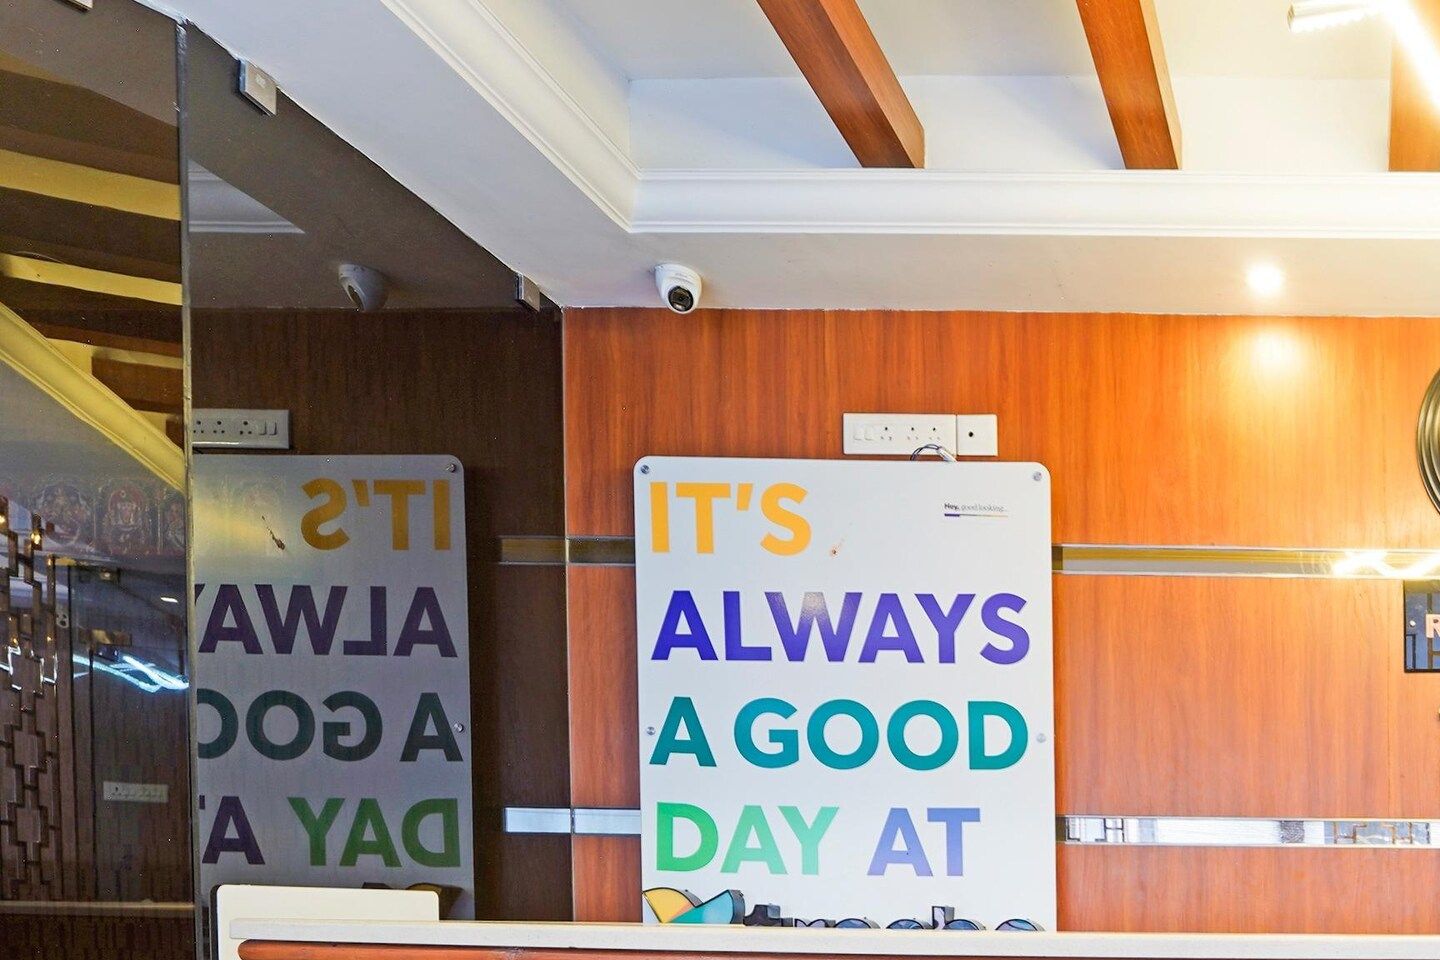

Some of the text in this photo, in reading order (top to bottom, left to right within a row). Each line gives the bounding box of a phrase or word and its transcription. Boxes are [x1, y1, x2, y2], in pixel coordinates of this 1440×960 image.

[650, 481, 813, 556] IT'S
[651, 590, 1031, 665] ALWAYS
[650, 696, 1028, 771] A GOOD
[657, 802, 980, 876] DAY AT
